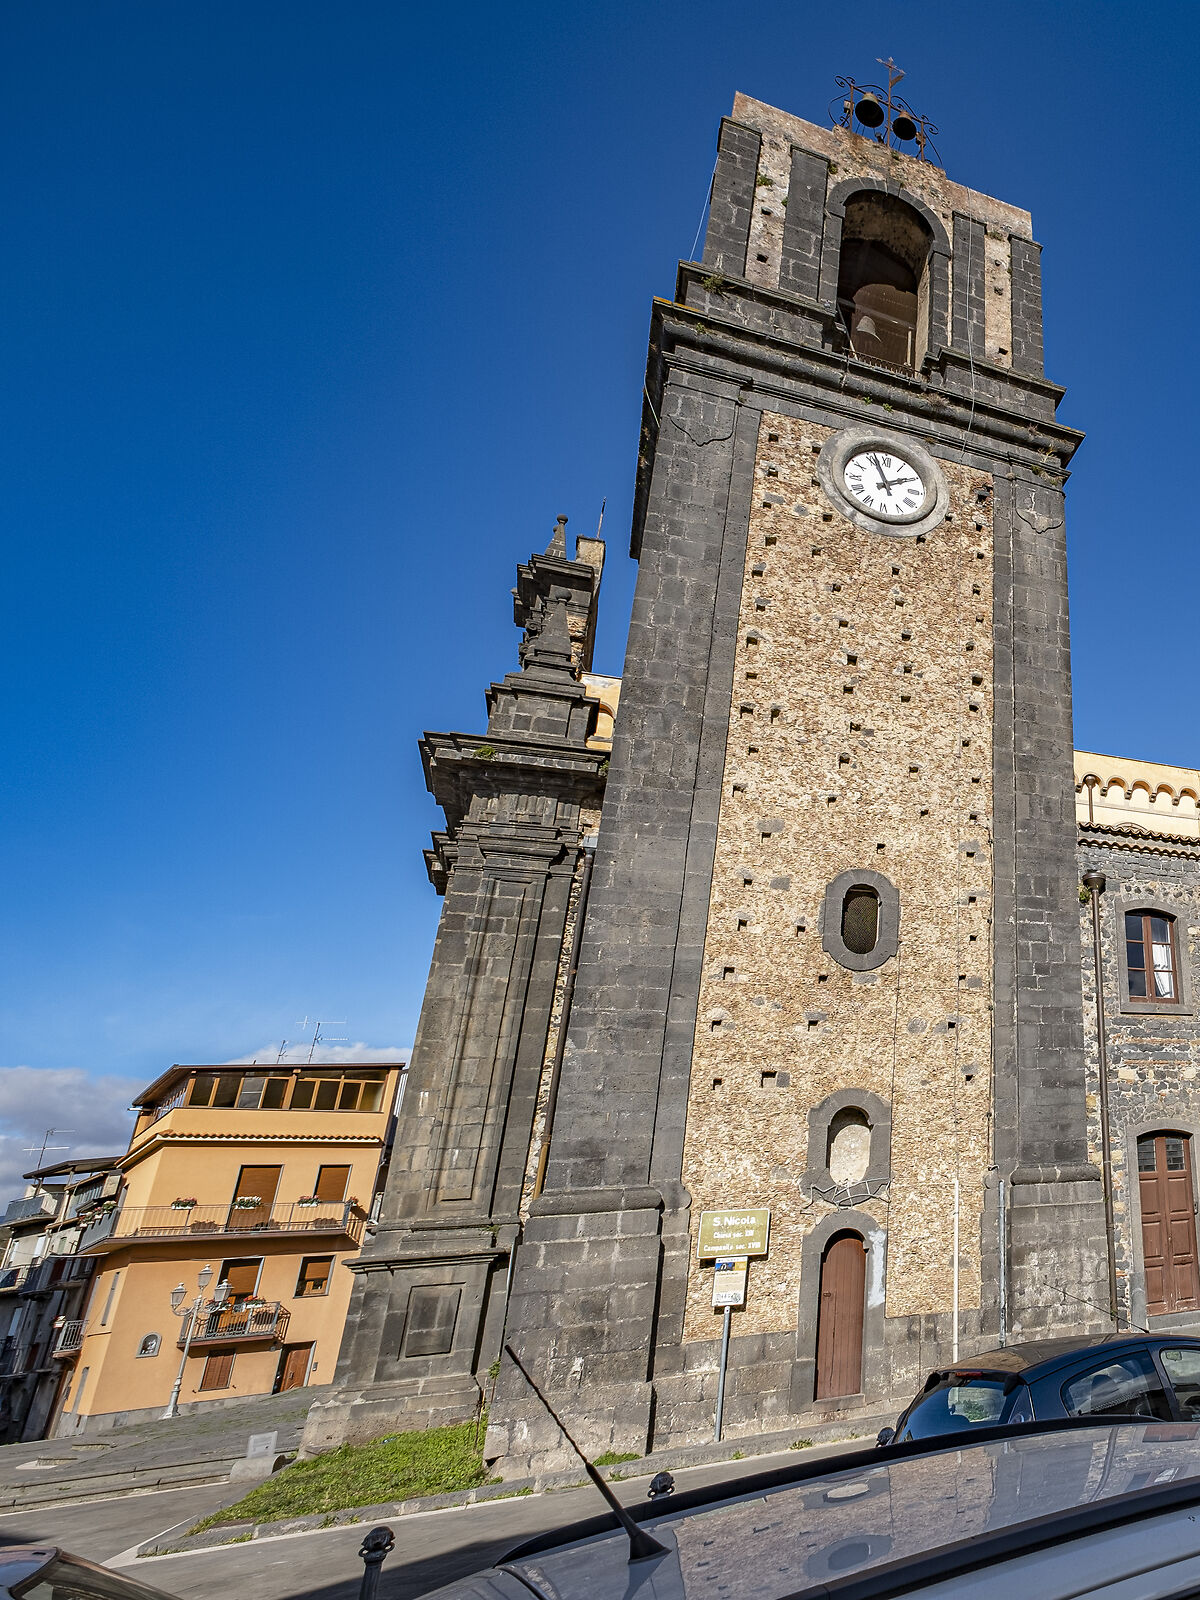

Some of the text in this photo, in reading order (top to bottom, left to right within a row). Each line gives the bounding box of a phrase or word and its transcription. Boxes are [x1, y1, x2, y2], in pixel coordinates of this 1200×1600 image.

[853, 461, 867, 471] X
[882, 456, 892, 468] XII
[851, 484, 865, 495] VIII
[862, 495, 874, 507] VII
[880, 502, 887, 513] VI
[895, 503, 904, 513] V
[704, 1243, 733, 1252] Campanile
